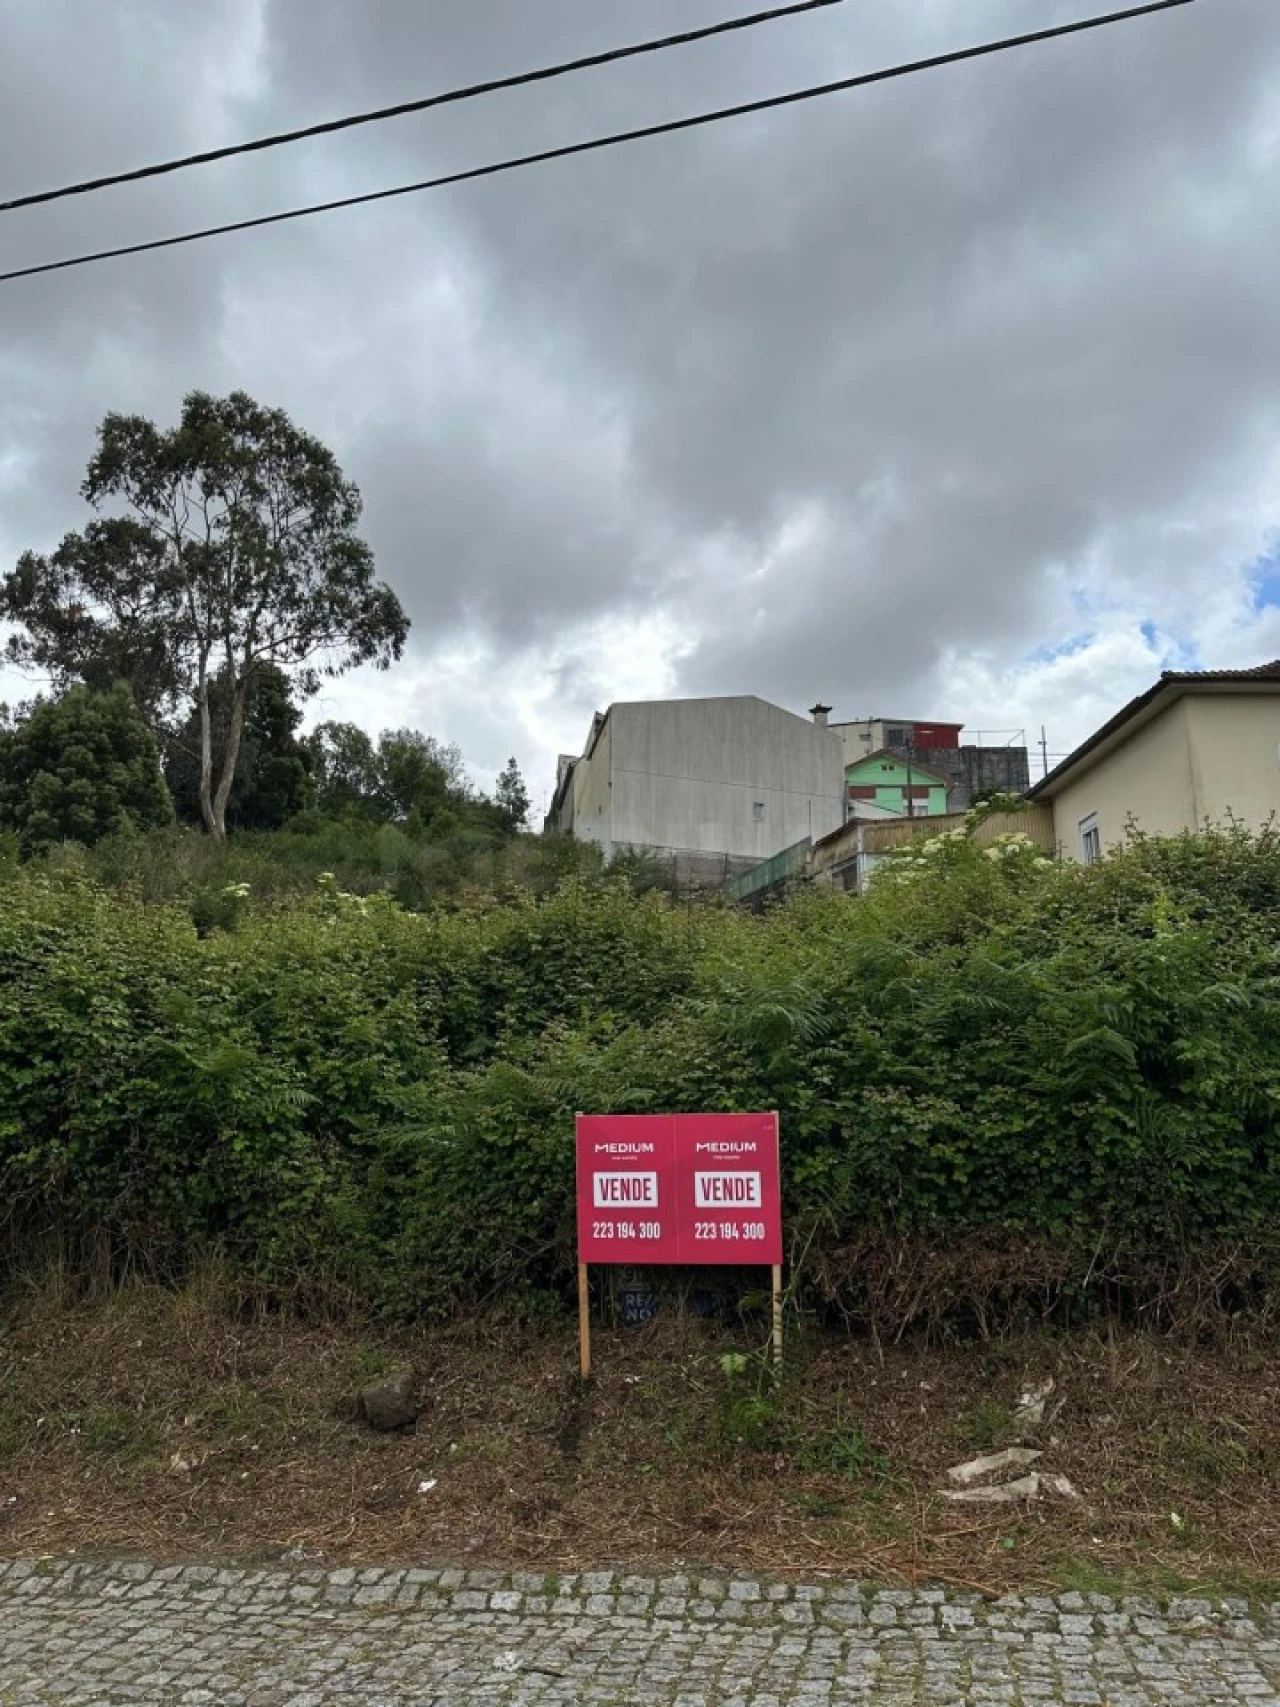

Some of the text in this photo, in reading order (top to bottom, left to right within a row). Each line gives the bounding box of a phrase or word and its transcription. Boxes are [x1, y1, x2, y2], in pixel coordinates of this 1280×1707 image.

[595, 1142, 654, 1153] MEDIUM
[696, 1141, 756, 1153] MEDIUM
[599, 1178, 652, 1201] VENDE
[701, 1177, 755, 1201] VENDE
[593, 1222, 661, 1239] 223 194 300
[694, 1222, 765, 1240] 223 194 300
